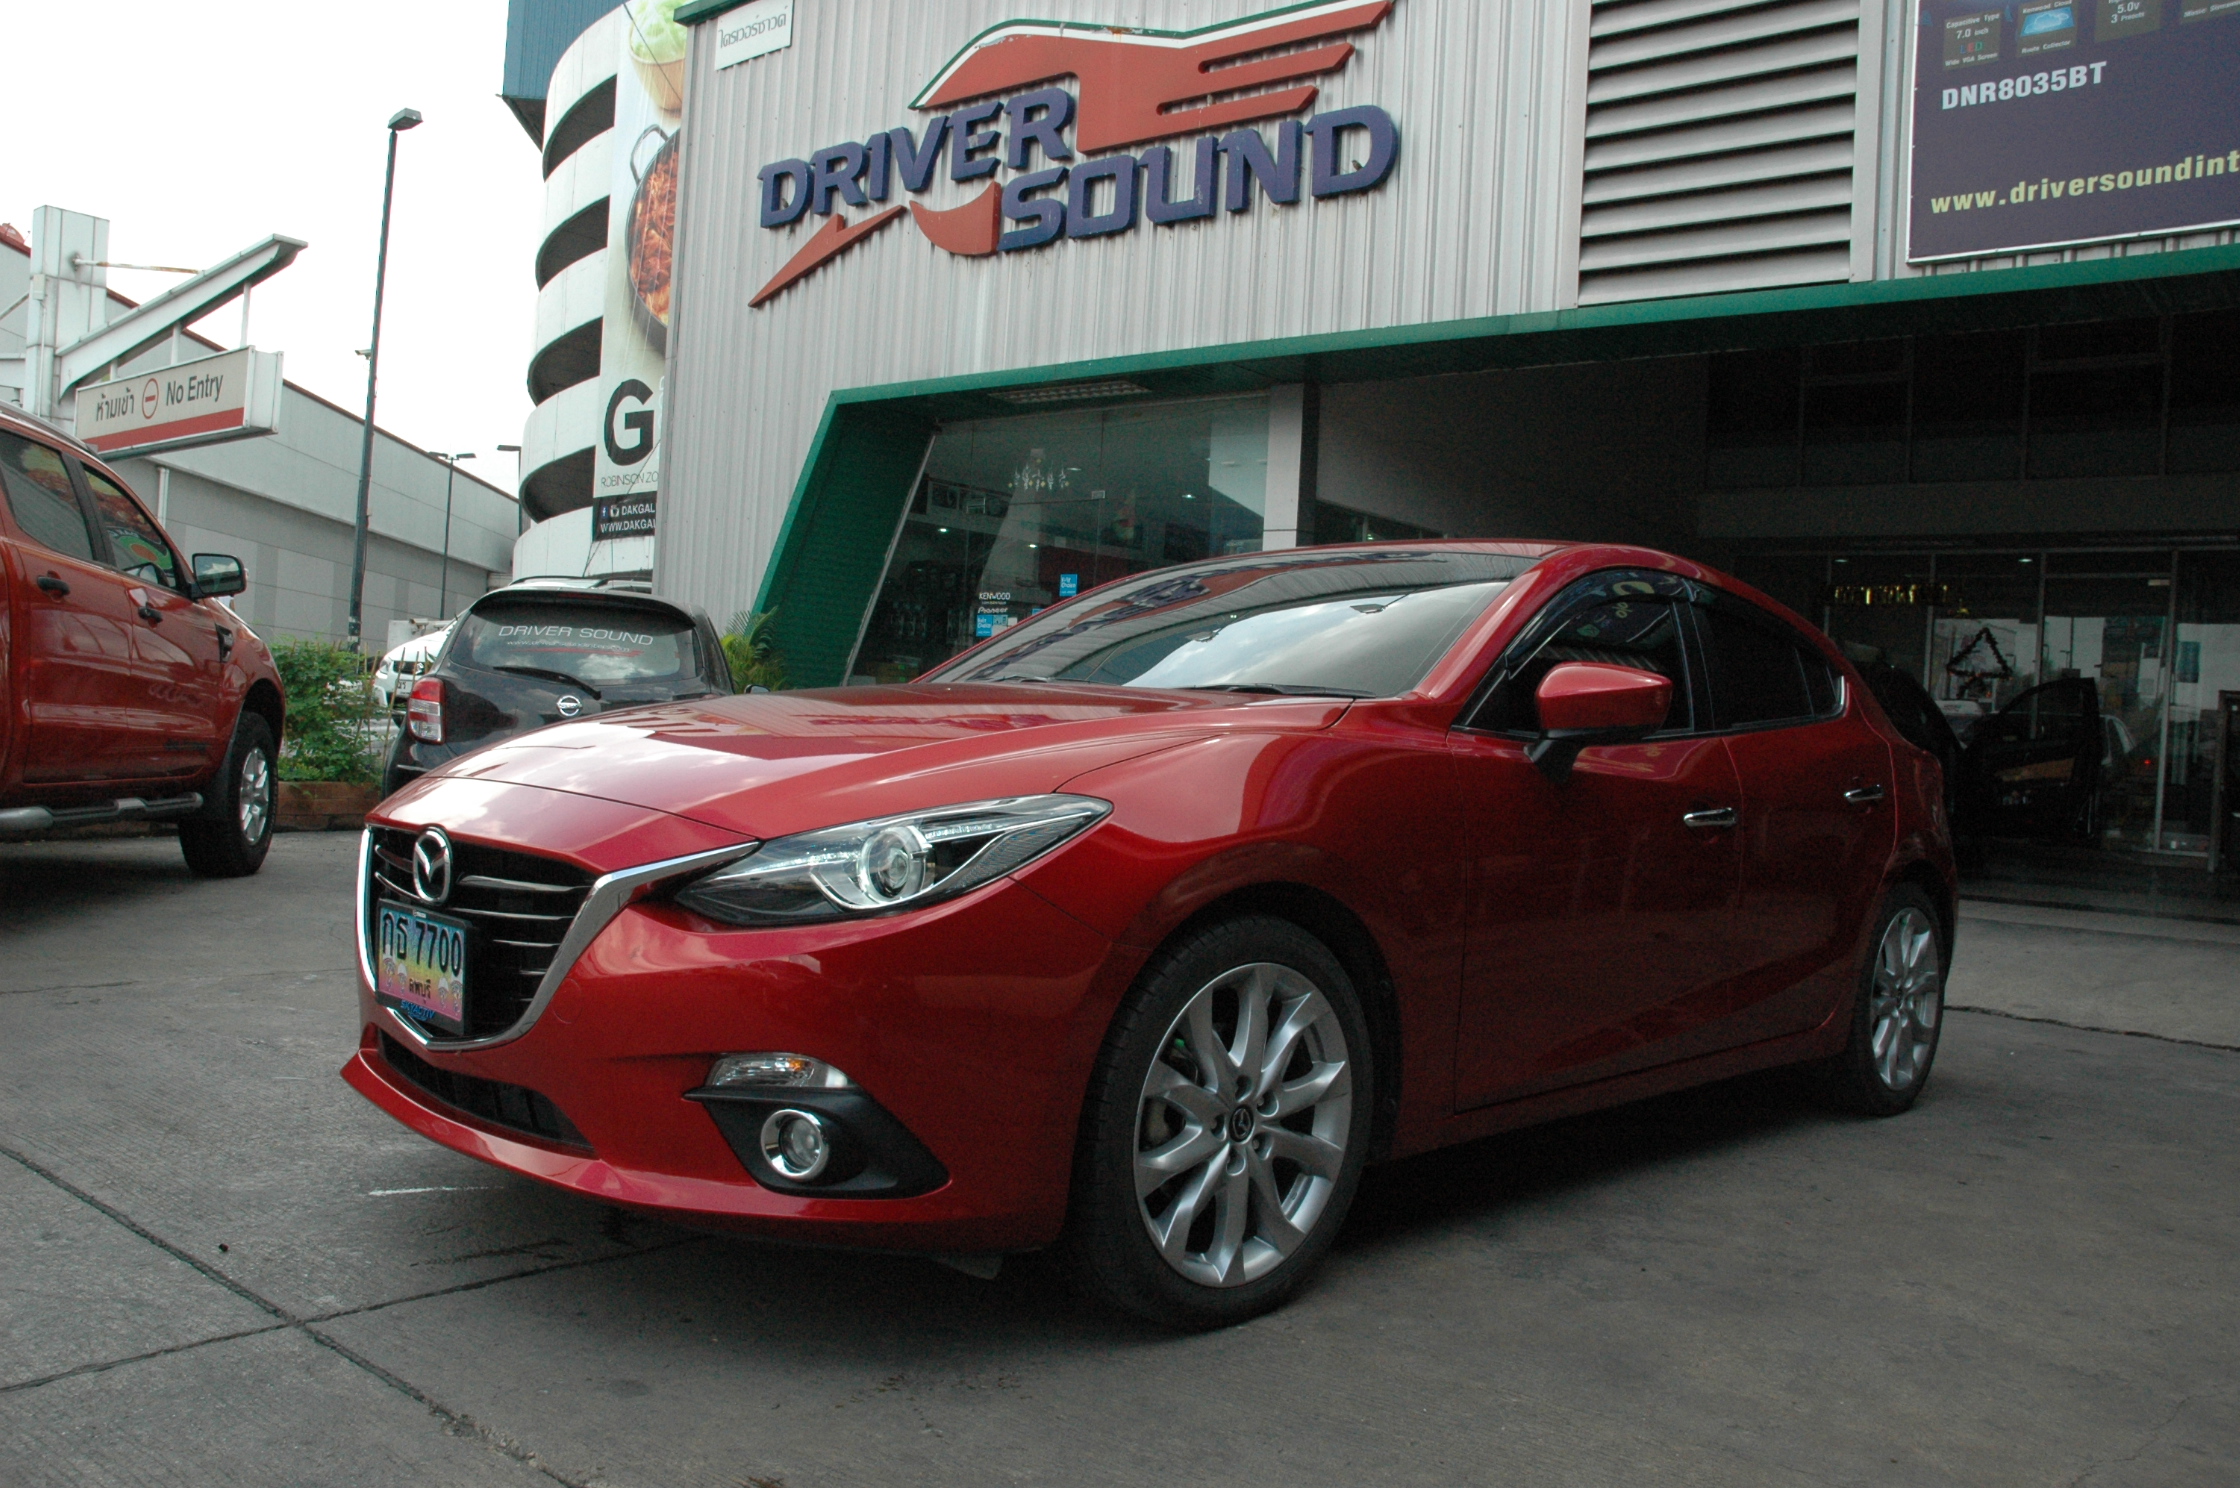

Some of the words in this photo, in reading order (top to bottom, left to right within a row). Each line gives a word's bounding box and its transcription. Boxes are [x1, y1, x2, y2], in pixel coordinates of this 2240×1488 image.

[1956, 28, 1971, 40] 7.0
[2111, 14, 2118, 24] 3
[1960, 41, 1983, 54] LED
[1942, 61, 2107, 110] DNR8035BT
[757, 86, 1076, 229] DRIVER
[997, 104, 1399, 253] SOUND
[96, 387, 135, 422] ห้ามเข้า
[166, 381, 184, 406] No
[188, 374, 224, 402] Entry
[604, 379, 655, 466] G
[979, 592, 1011, 600] KENWOOD
[498, 625, 573, 637] DRIVER
[579, 628, 654, 646] SOUND
[415, 920, 462, 977] 7700
